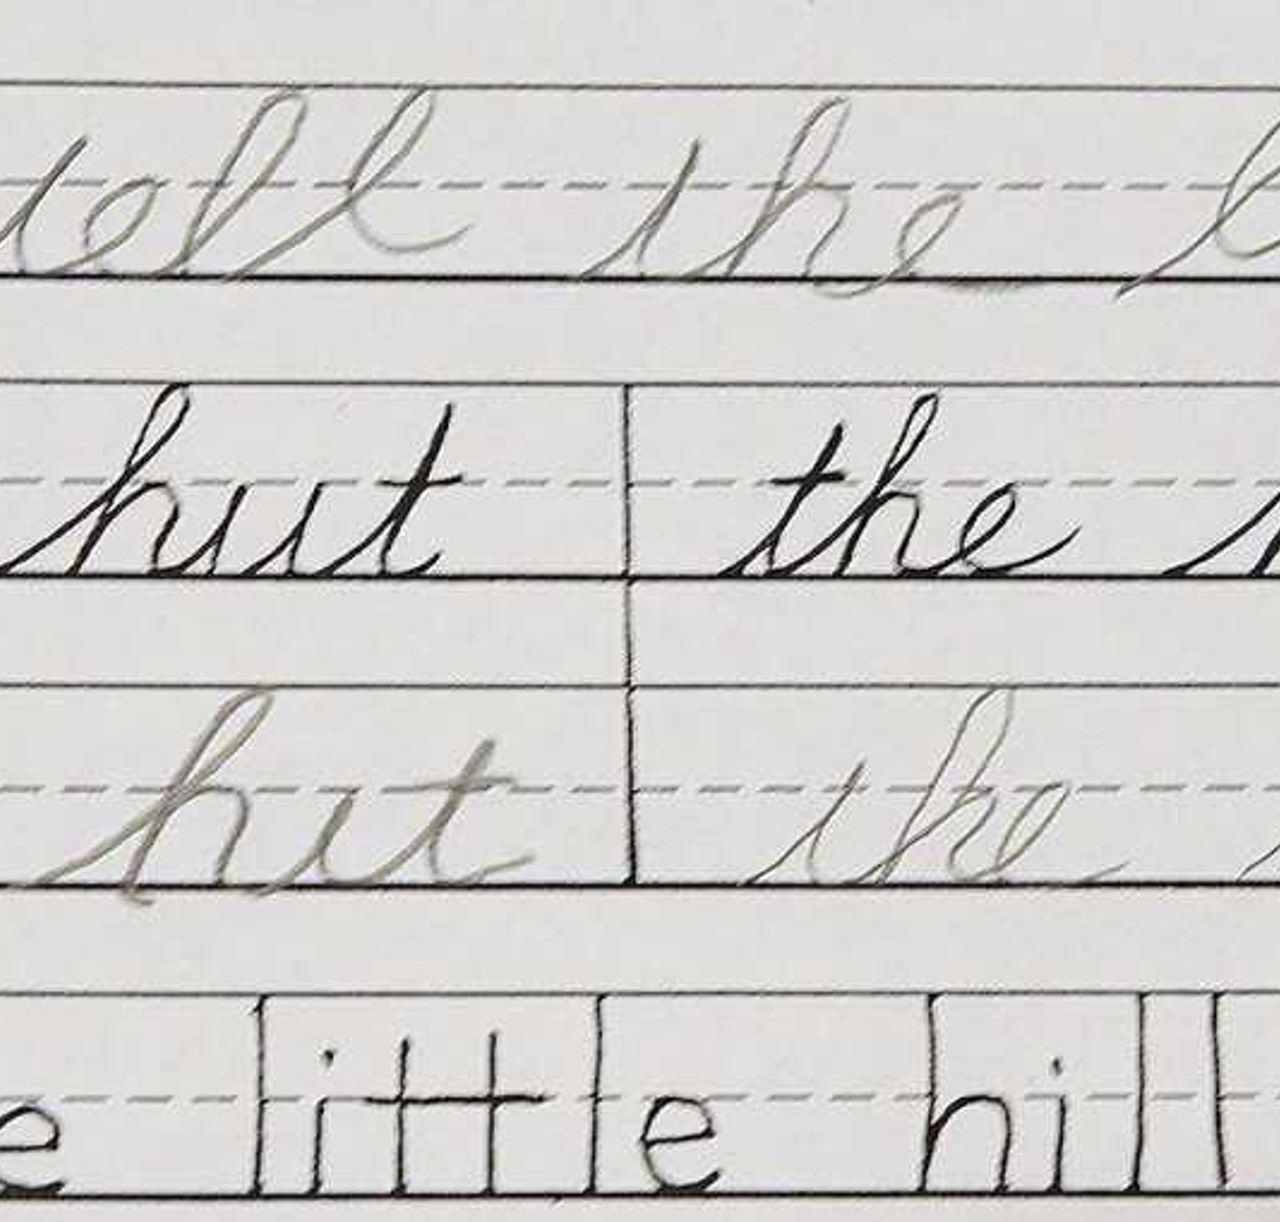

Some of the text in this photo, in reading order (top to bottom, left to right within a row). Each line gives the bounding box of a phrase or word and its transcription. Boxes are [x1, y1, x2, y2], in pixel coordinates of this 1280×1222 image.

[570, 94, 1038, 298] the
[721, 391, 1082, 579] the
[18, 684, 534, 906] hut
[740, 684, 1130, 887] the
[248, 994, 721, 1197] little
[920, 991, 1229, 1195] hill
